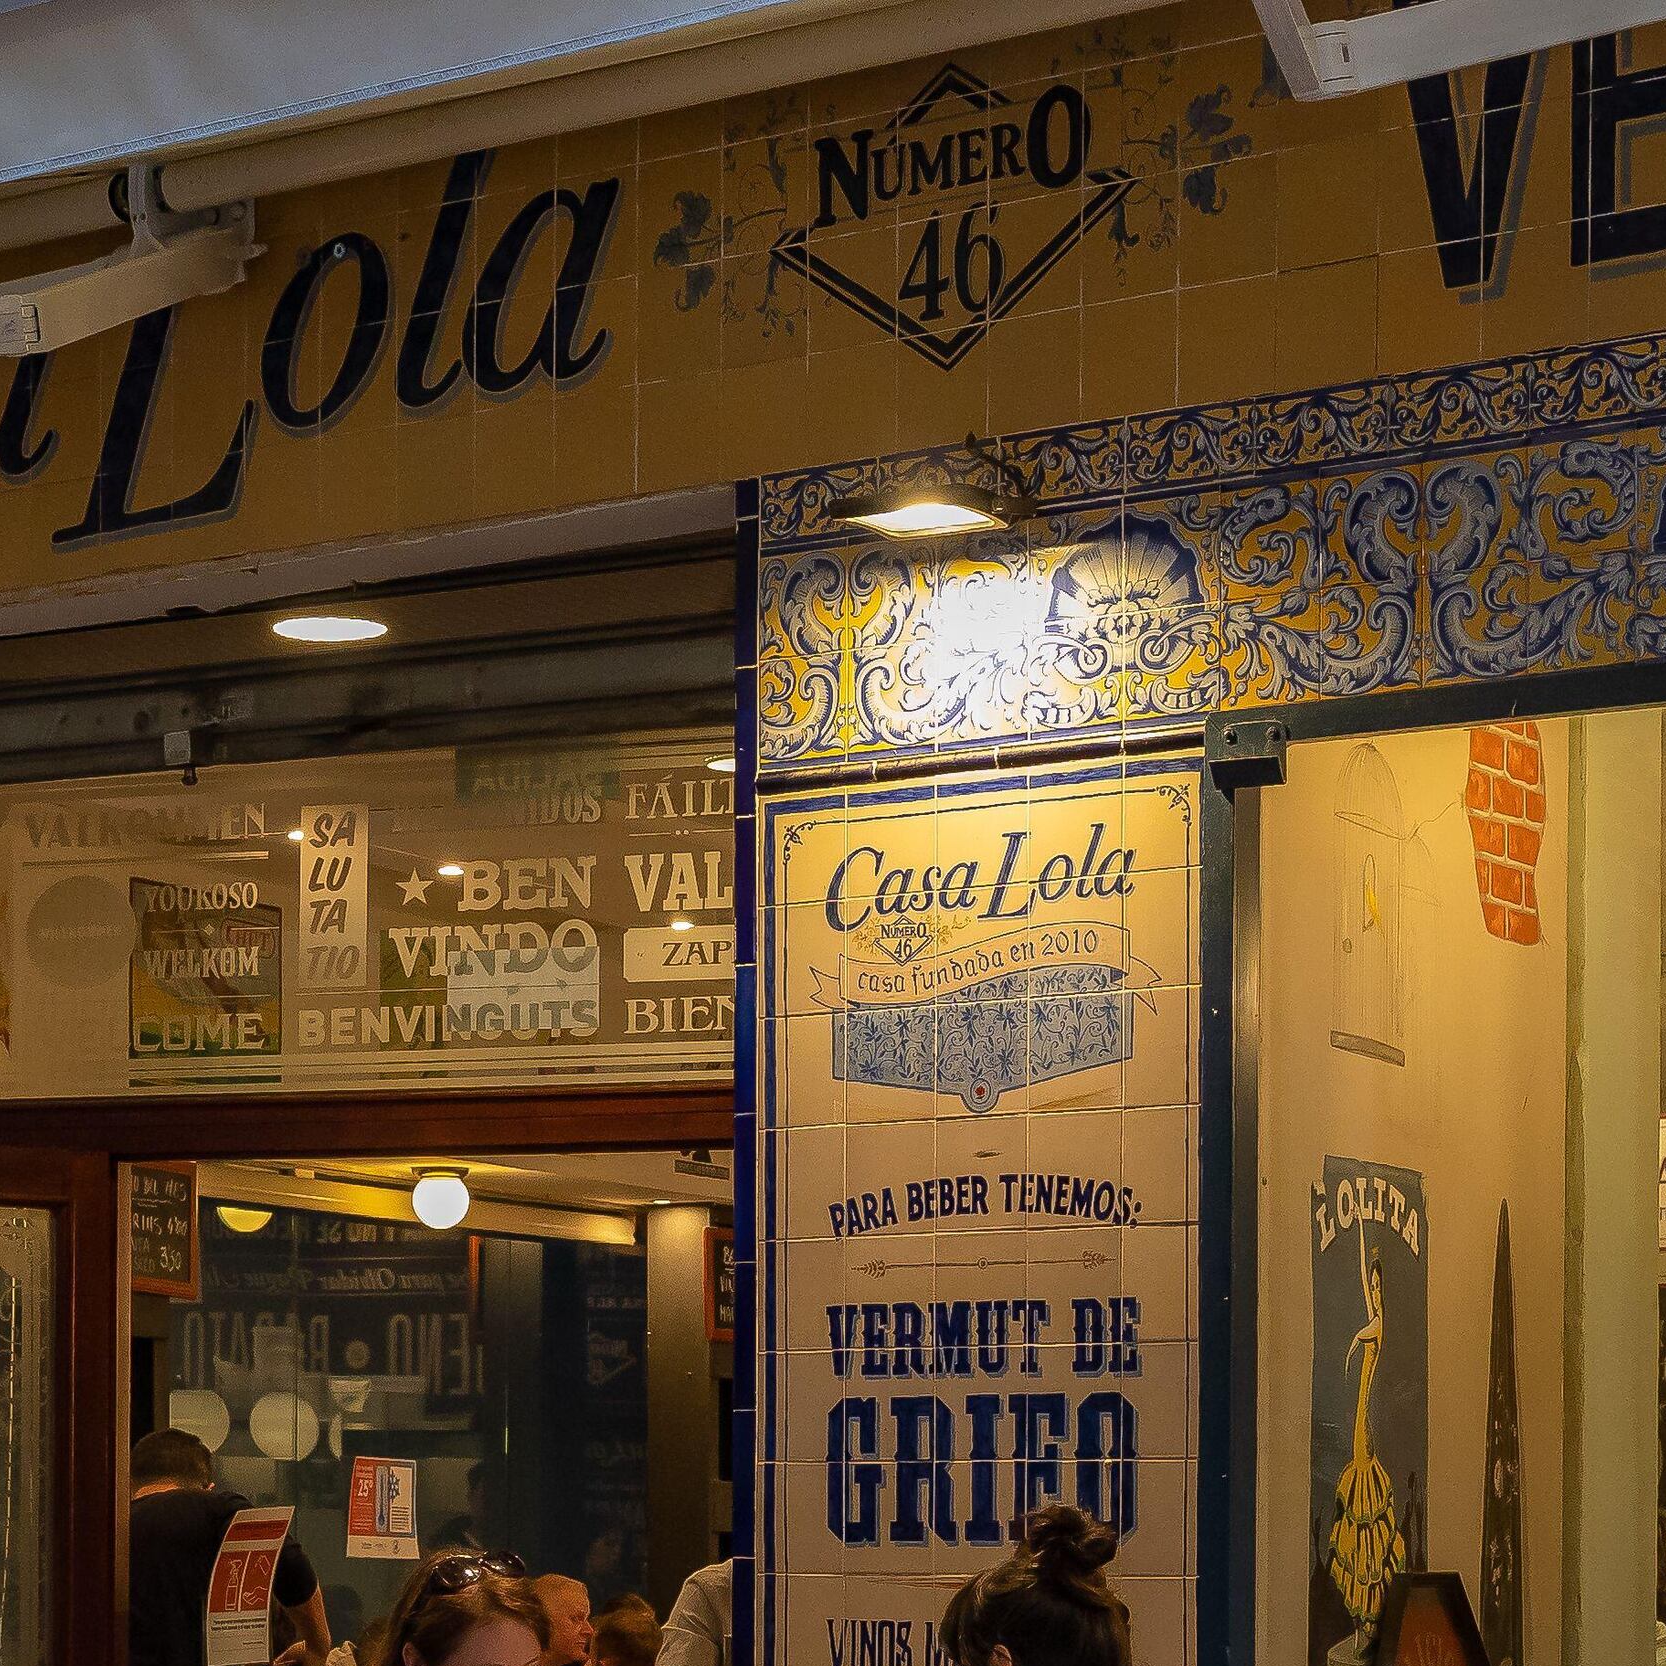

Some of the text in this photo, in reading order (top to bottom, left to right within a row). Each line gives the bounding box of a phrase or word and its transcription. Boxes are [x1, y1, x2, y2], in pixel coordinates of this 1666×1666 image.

[896, 200, 1007, 322] 46
[51, 147, 620, 550] Lola
[308, 810, 357, 847] SA
[145, 882, 259, 913] YOUKOSO
[307, 857, 353, 892] LU
[458, 855, 597, 912] BEN
[824, 823, 1136, 933] Casa Lola
[308, 899, 348, 935] TA
[142, 946, 261, 981] WELKOM
[306, 945, 361, 981] TIO
[389, 918, 598, 978] VINDO
[857, 929, 1099, 997] casa fundada en 2010
[893, 938, 913, 959] 46
[298, 1000, 599, 1047] BENVINGUTS
[828, 1173, 1143, 1239] PARA BEBER TENEMOS:
[1315, 1176, 1420, 1259] LOLITA
[826, 1296, 1143, 1379] VERMUT DE
[826, 1391, 1140, 1549] GRIFO
